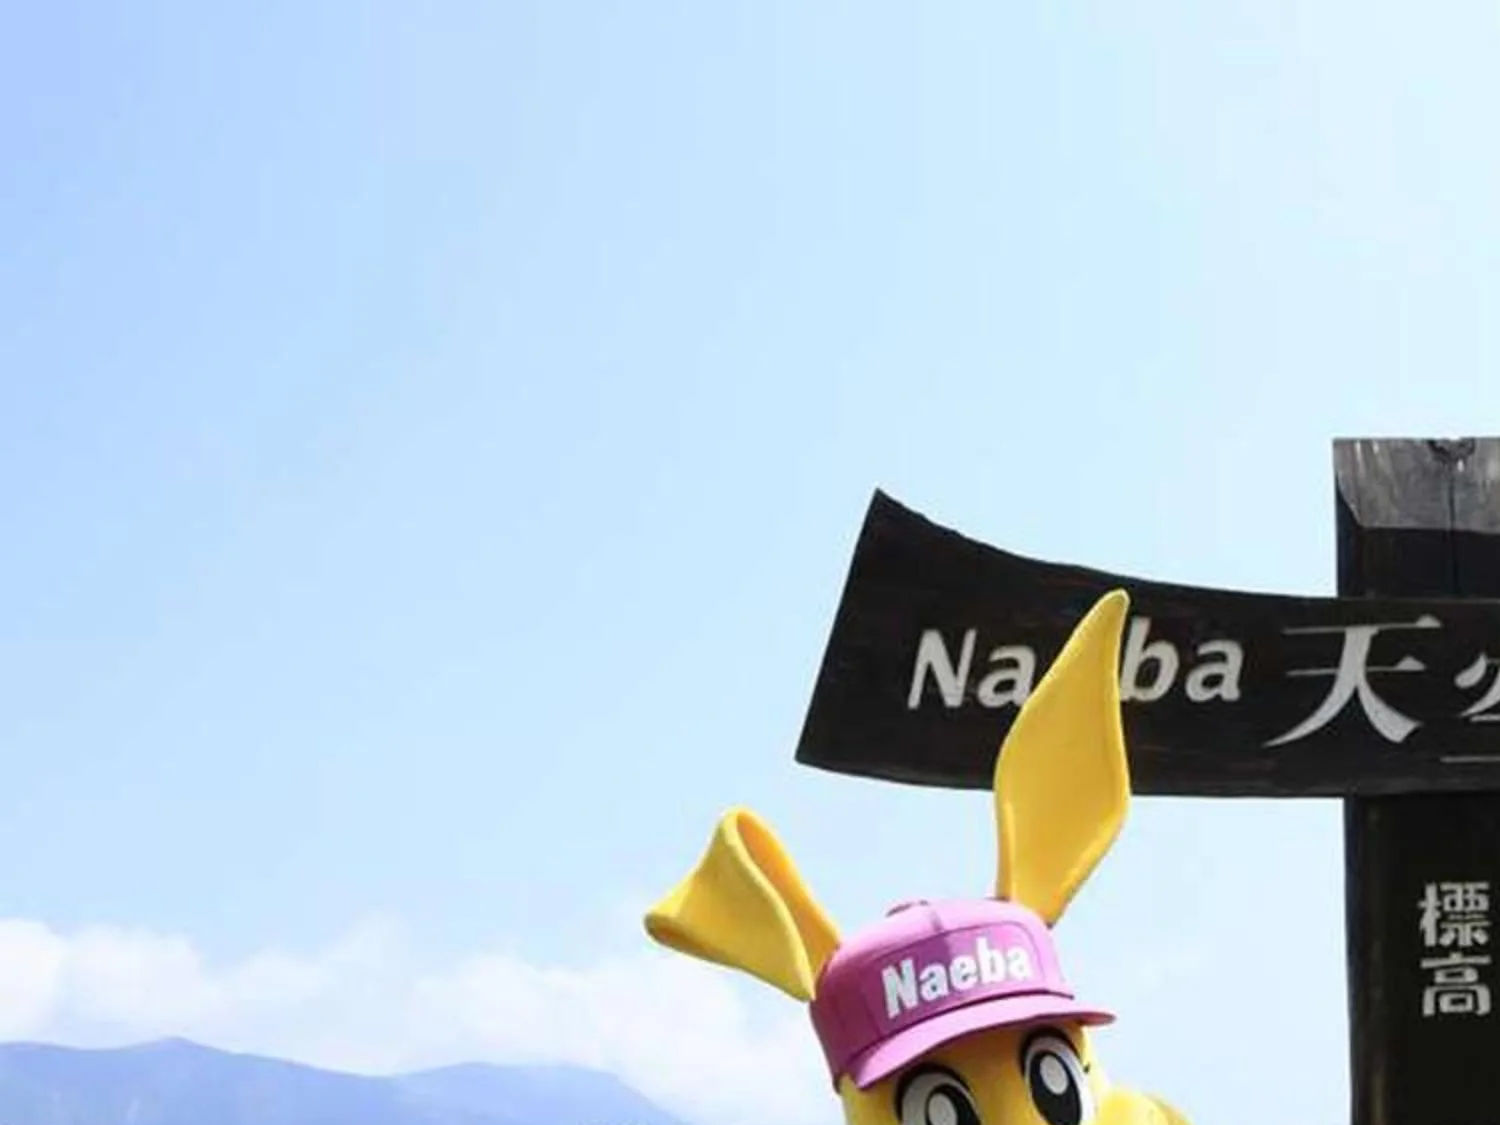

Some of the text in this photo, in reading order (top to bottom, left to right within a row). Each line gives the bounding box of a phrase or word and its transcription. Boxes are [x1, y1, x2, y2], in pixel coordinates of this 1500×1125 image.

[907, 617, 1244, 709] Naba
[881, 937, 1035, 1020] Naeba
[1418, 881, 1492, 1017] 標高
